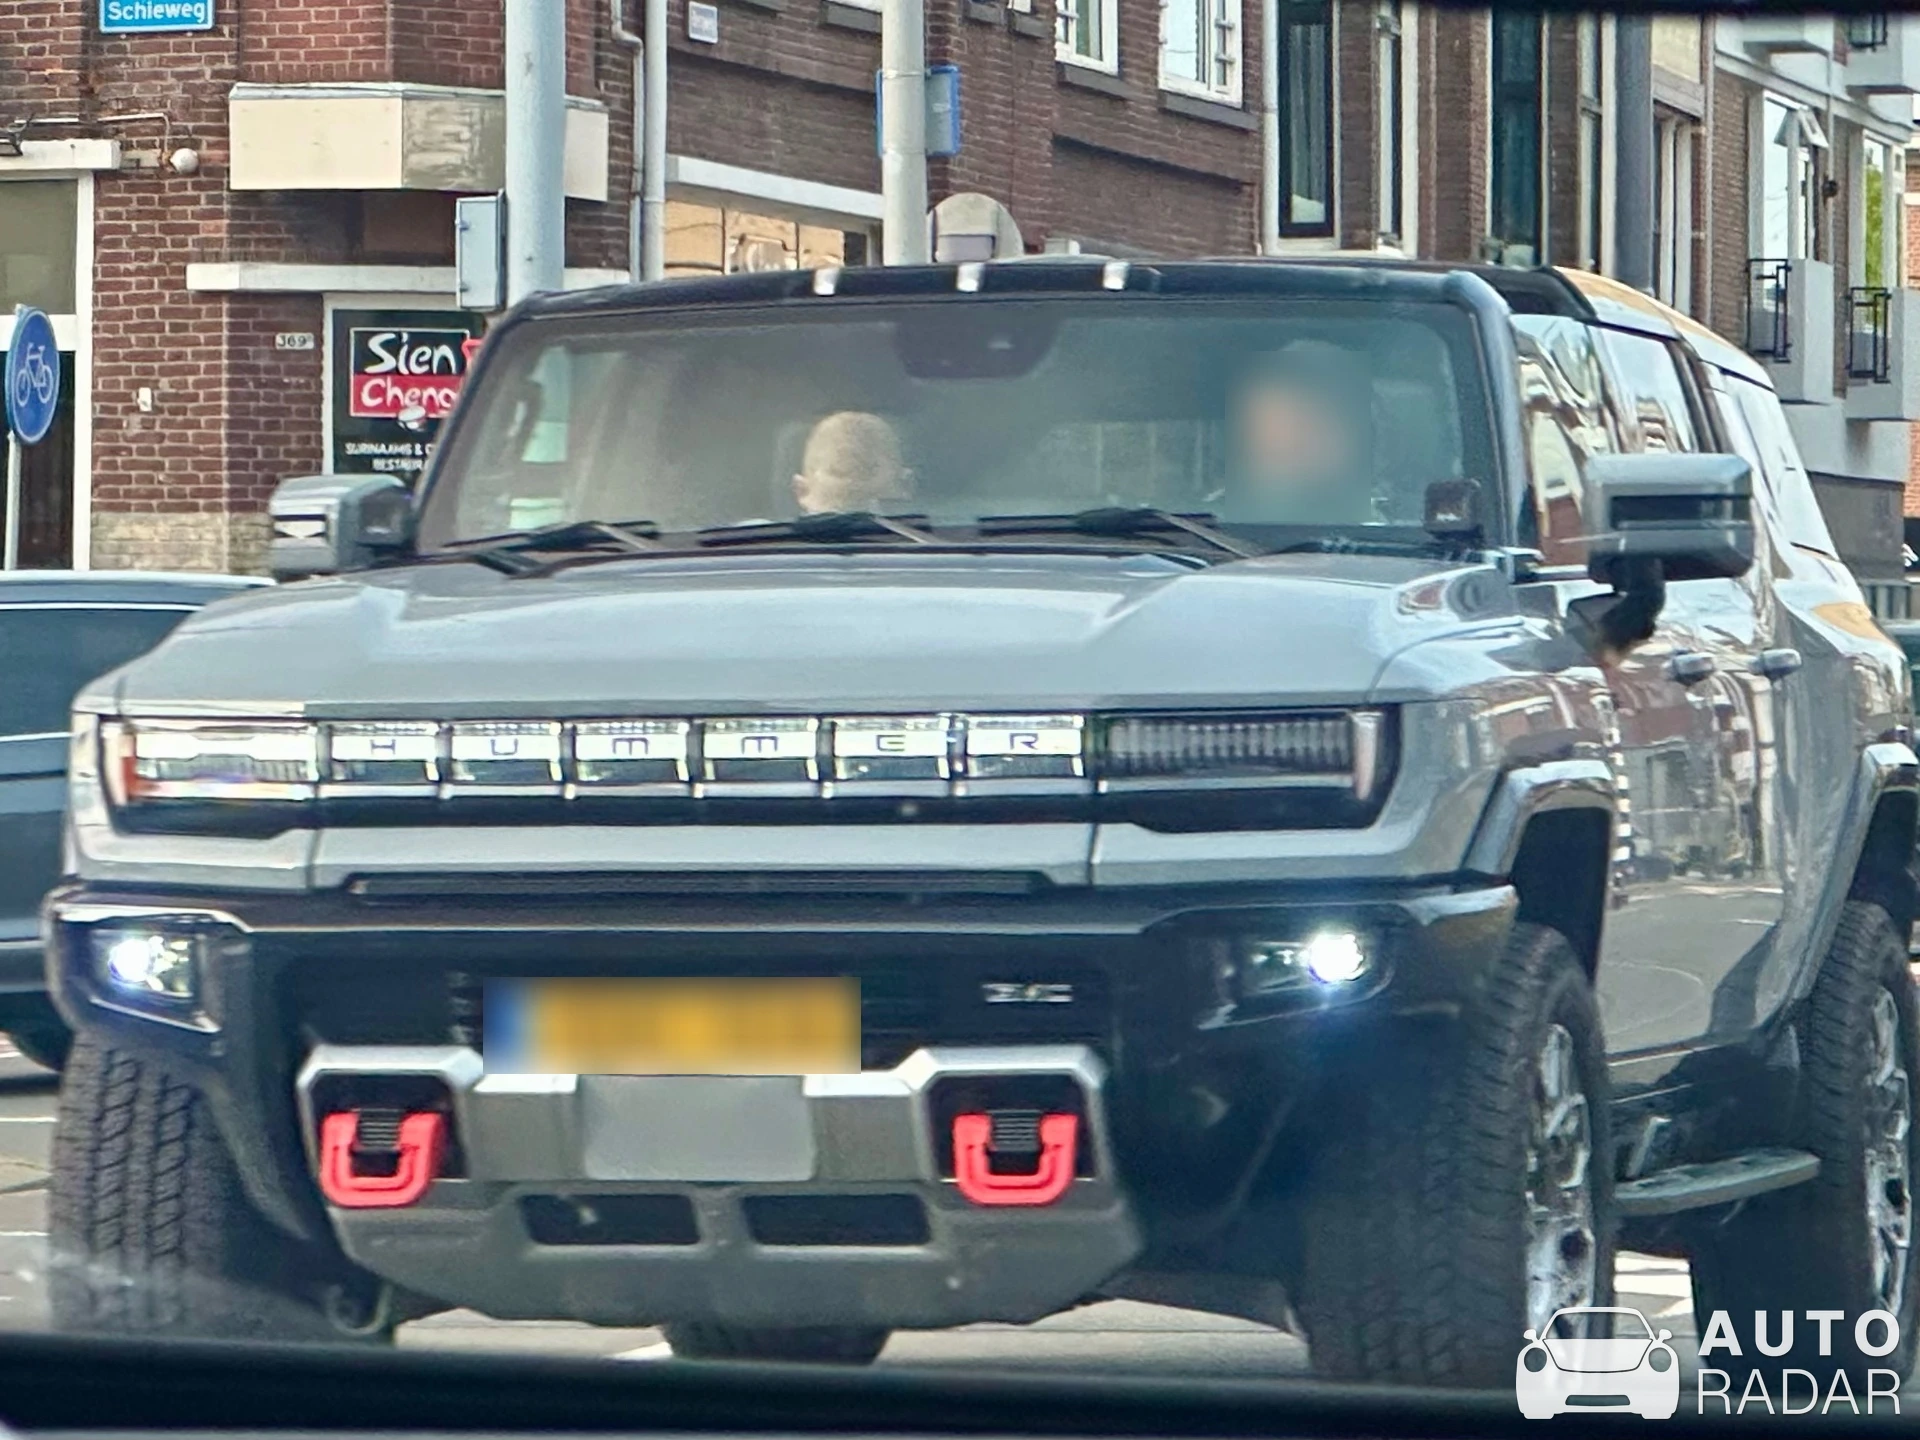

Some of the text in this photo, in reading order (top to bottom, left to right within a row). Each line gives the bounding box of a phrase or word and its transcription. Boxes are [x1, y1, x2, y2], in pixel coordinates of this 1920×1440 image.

[107, 1, 206, 23] Schieweg
[364, 332, 457, 375] Sien
[372, 458, 425, 471] RESTAUR
[370, 732, 1039, 757] HUMMER
